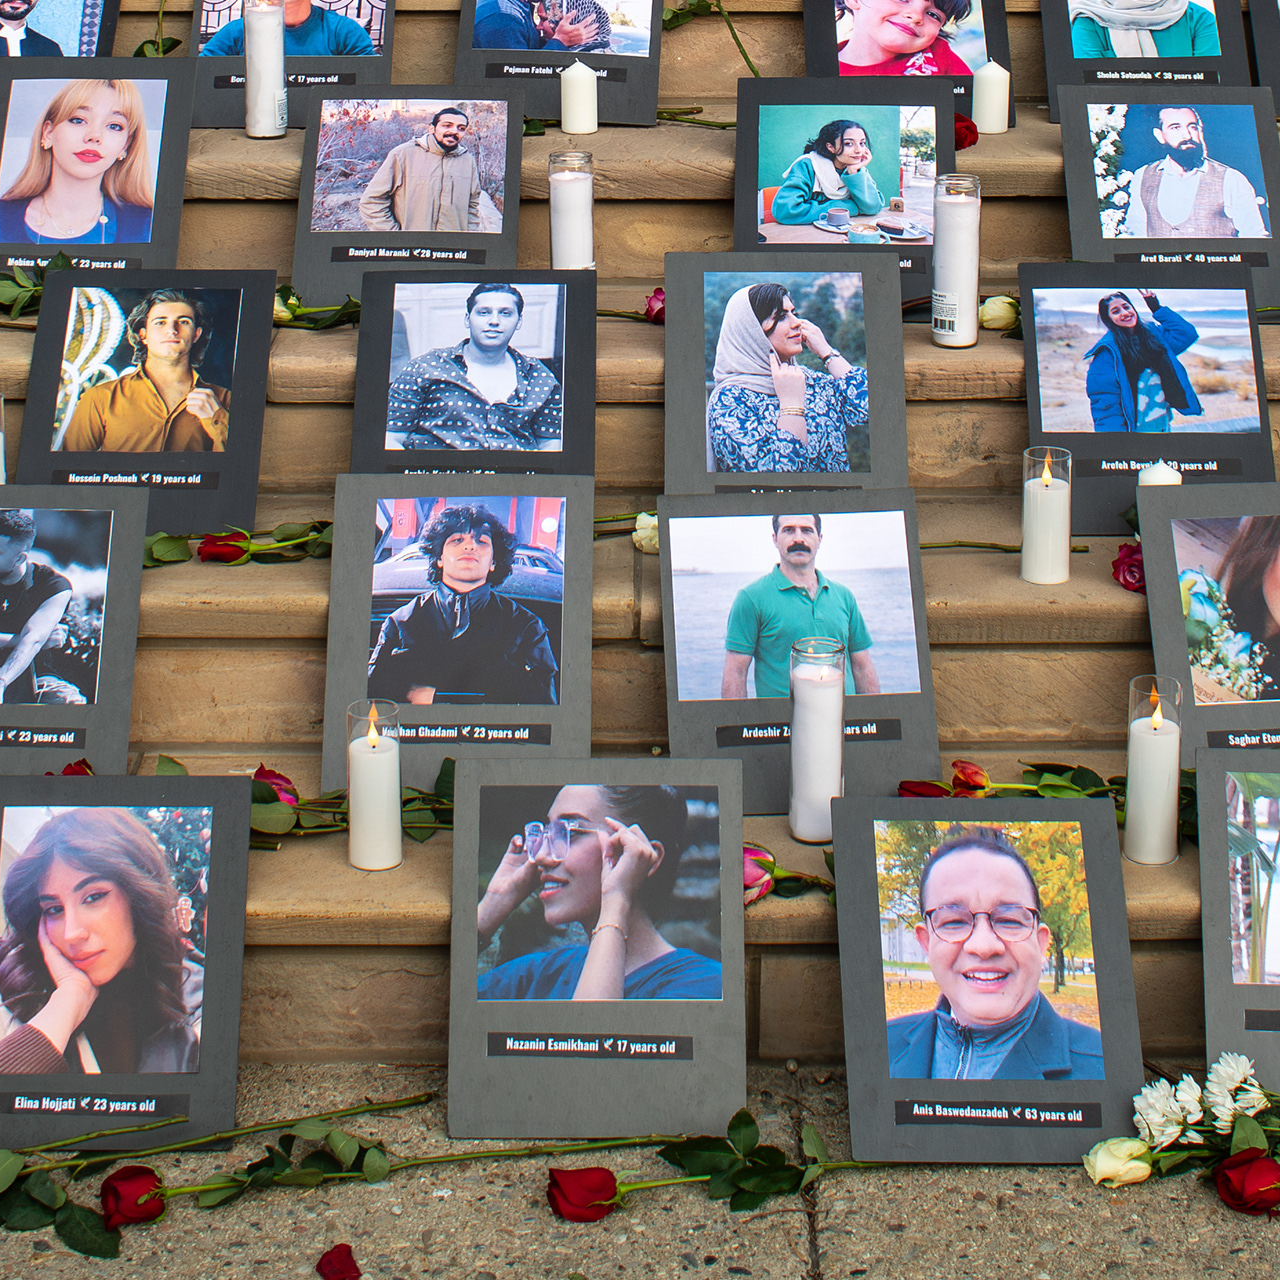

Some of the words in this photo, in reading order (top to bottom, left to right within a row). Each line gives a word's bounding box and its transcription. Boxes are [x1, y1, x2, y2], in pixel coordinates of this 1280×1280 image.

[506, 1037, 545, 1051] Nazanin
[547, 1038, 599, 1052] Esmikhani
[616, 1040, 627, 1052] 17
[629, 1041, 658, 1055] years
[660, 1040, 676, 1054] old
[13, 1096, 39, 1109] Elina
[41, 1097, 76, 1112] Hojjati
[93, 1098, 108, 1110] 23
[109, 1100, 137, 1113] years
[138, 1099, 155, 1111] old
[912, 1103, 933, 1116] Anis
[935, 1104, 1009, 1119] Baswedanzadeh
[1024, 1107, 1038, 1119] 63
[1039, 1109, 1067, 1122] years
[1067, 1109, 1083, 1122] old
